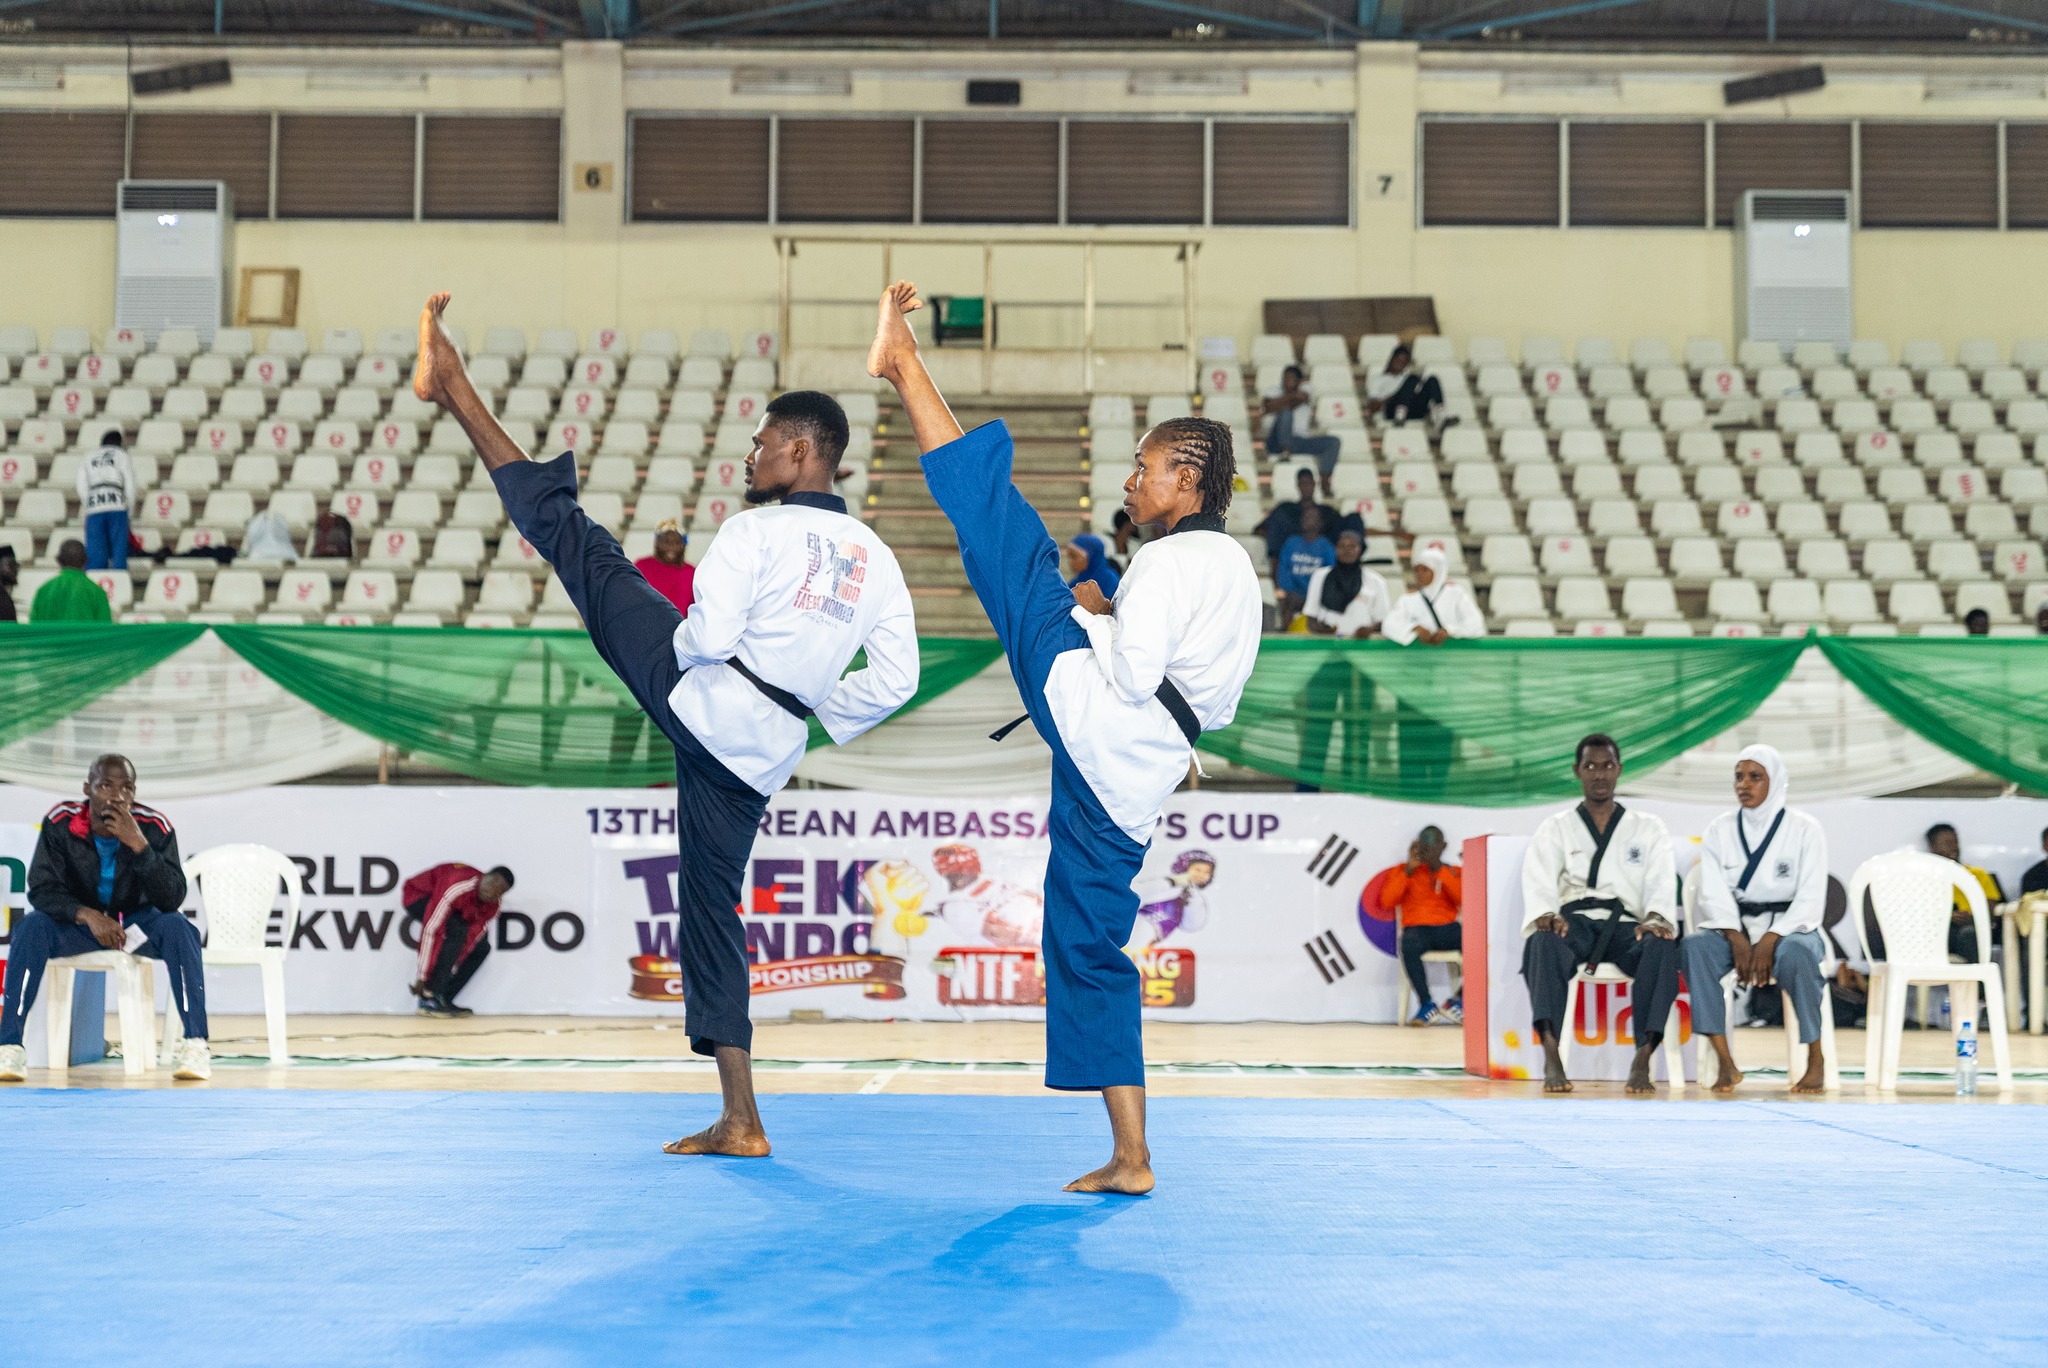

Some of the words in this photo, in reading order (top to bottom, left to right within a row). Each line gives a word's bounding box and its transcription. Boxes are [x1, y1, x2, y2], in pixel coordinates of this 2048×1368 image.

[585, 167, 601, 190] 6
[1376, 174, 1392, 195] 7
[793, 591, 855, 623] TAEKWONDO
[585, 808, 676, 836] 13TH
[759, 809, 856, 837] REAN
[1202, 813, 1280, 840] CUP
[622, 855, 882, 917] TEK
[635, 921, 874, 965] WNDO
[950, 953, 1024, 1001] NTF
